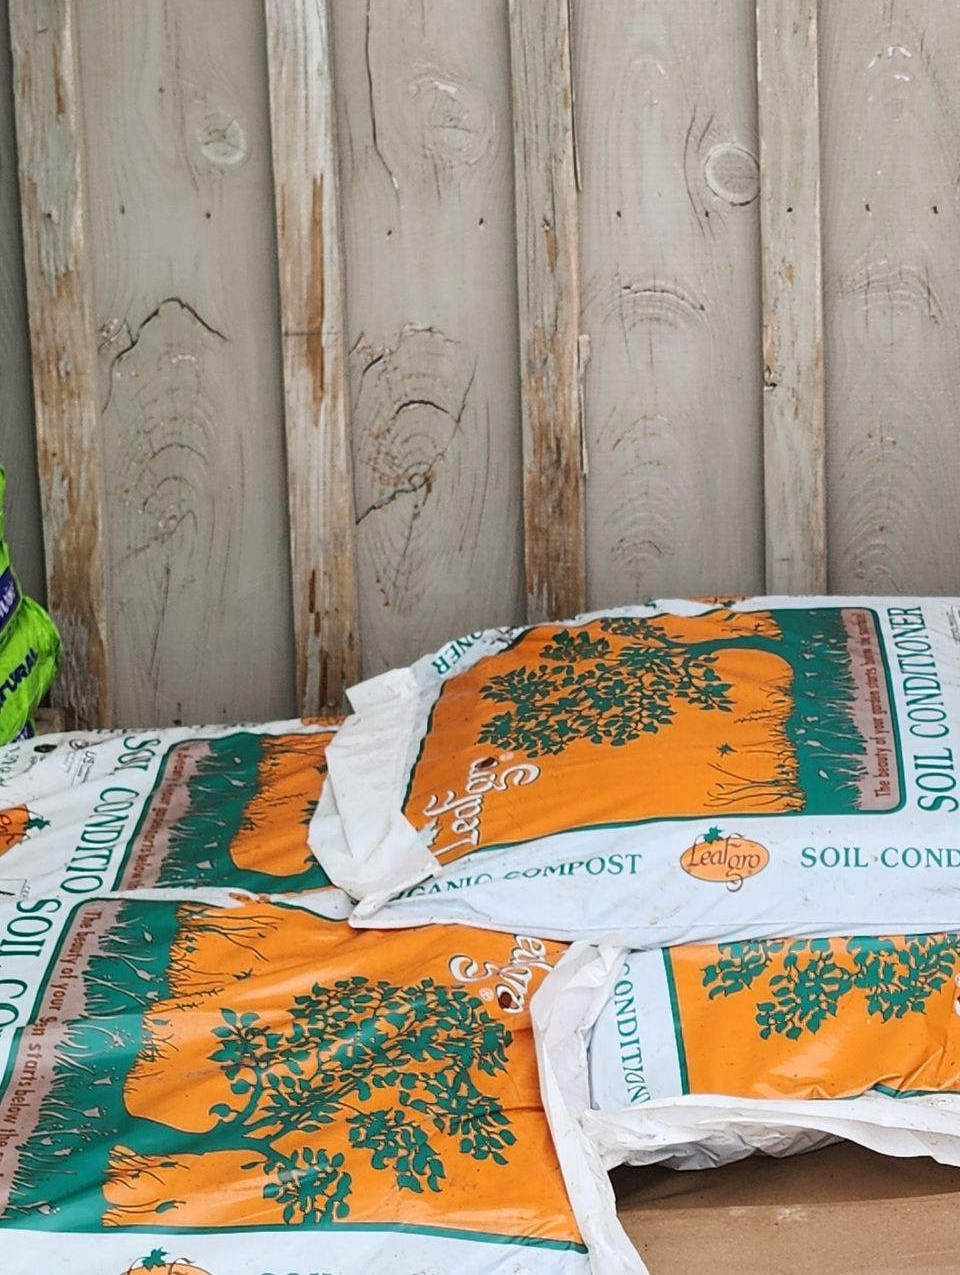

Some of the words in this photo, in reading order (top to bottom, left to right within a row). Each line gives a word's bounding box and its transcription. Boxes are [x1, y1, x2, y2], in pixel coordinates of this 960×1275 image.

[887, 606, 950, 738] CONDITIONER
[874, 745, 893, 777] beauty
[874, 779, 891, 798] The
[914, 747, 959, 813] SOIL
[423, 756, 541, 855] Leafgro
[503, 853, 643, 881] COMPOST
[686, 833, 763, 893] Leafgro
[800, 847, 869, 869] SOIL
[76, 911, 102, 931] The
[65, 929, 96, 965] beauty
[59, 964, 77, 981] of
[48, 982, 66, 1016] your
[23, 1043, 45, 1092] starts
[4, 1087, 33, 1128] below
